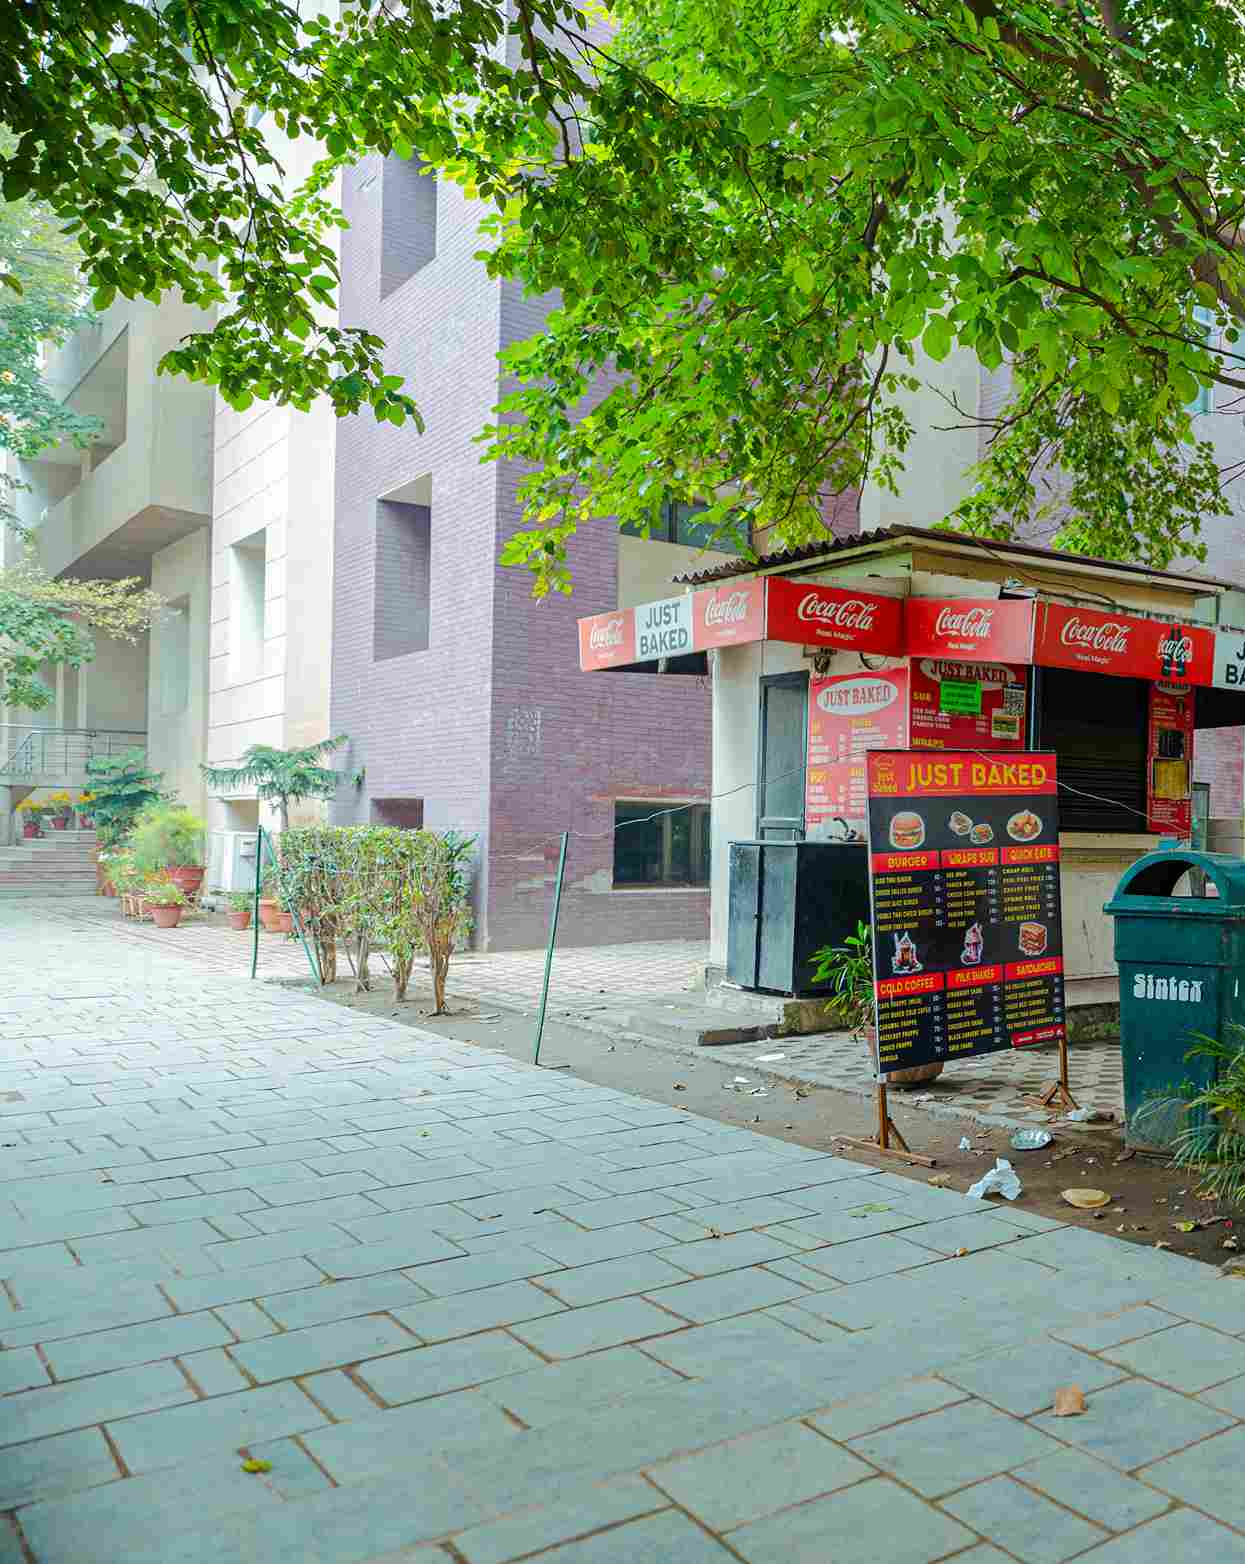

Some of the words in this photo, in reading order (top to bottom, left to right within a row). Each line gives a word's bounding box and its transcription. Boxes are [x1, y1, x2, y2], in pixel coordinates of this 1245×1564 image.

[645, 602, 681, 629] JUST
[640, 627, 688, 655] BAKED
[824, 688, 849, 707] JUST
[852, 685, 891, 705] BAKED
[907, 763, 963, 792] JUST
[972, 763, 1047, 786] BAKED
[880, 981, 903, 994] COLD
[904, 977, 936, 992] COFFEE
